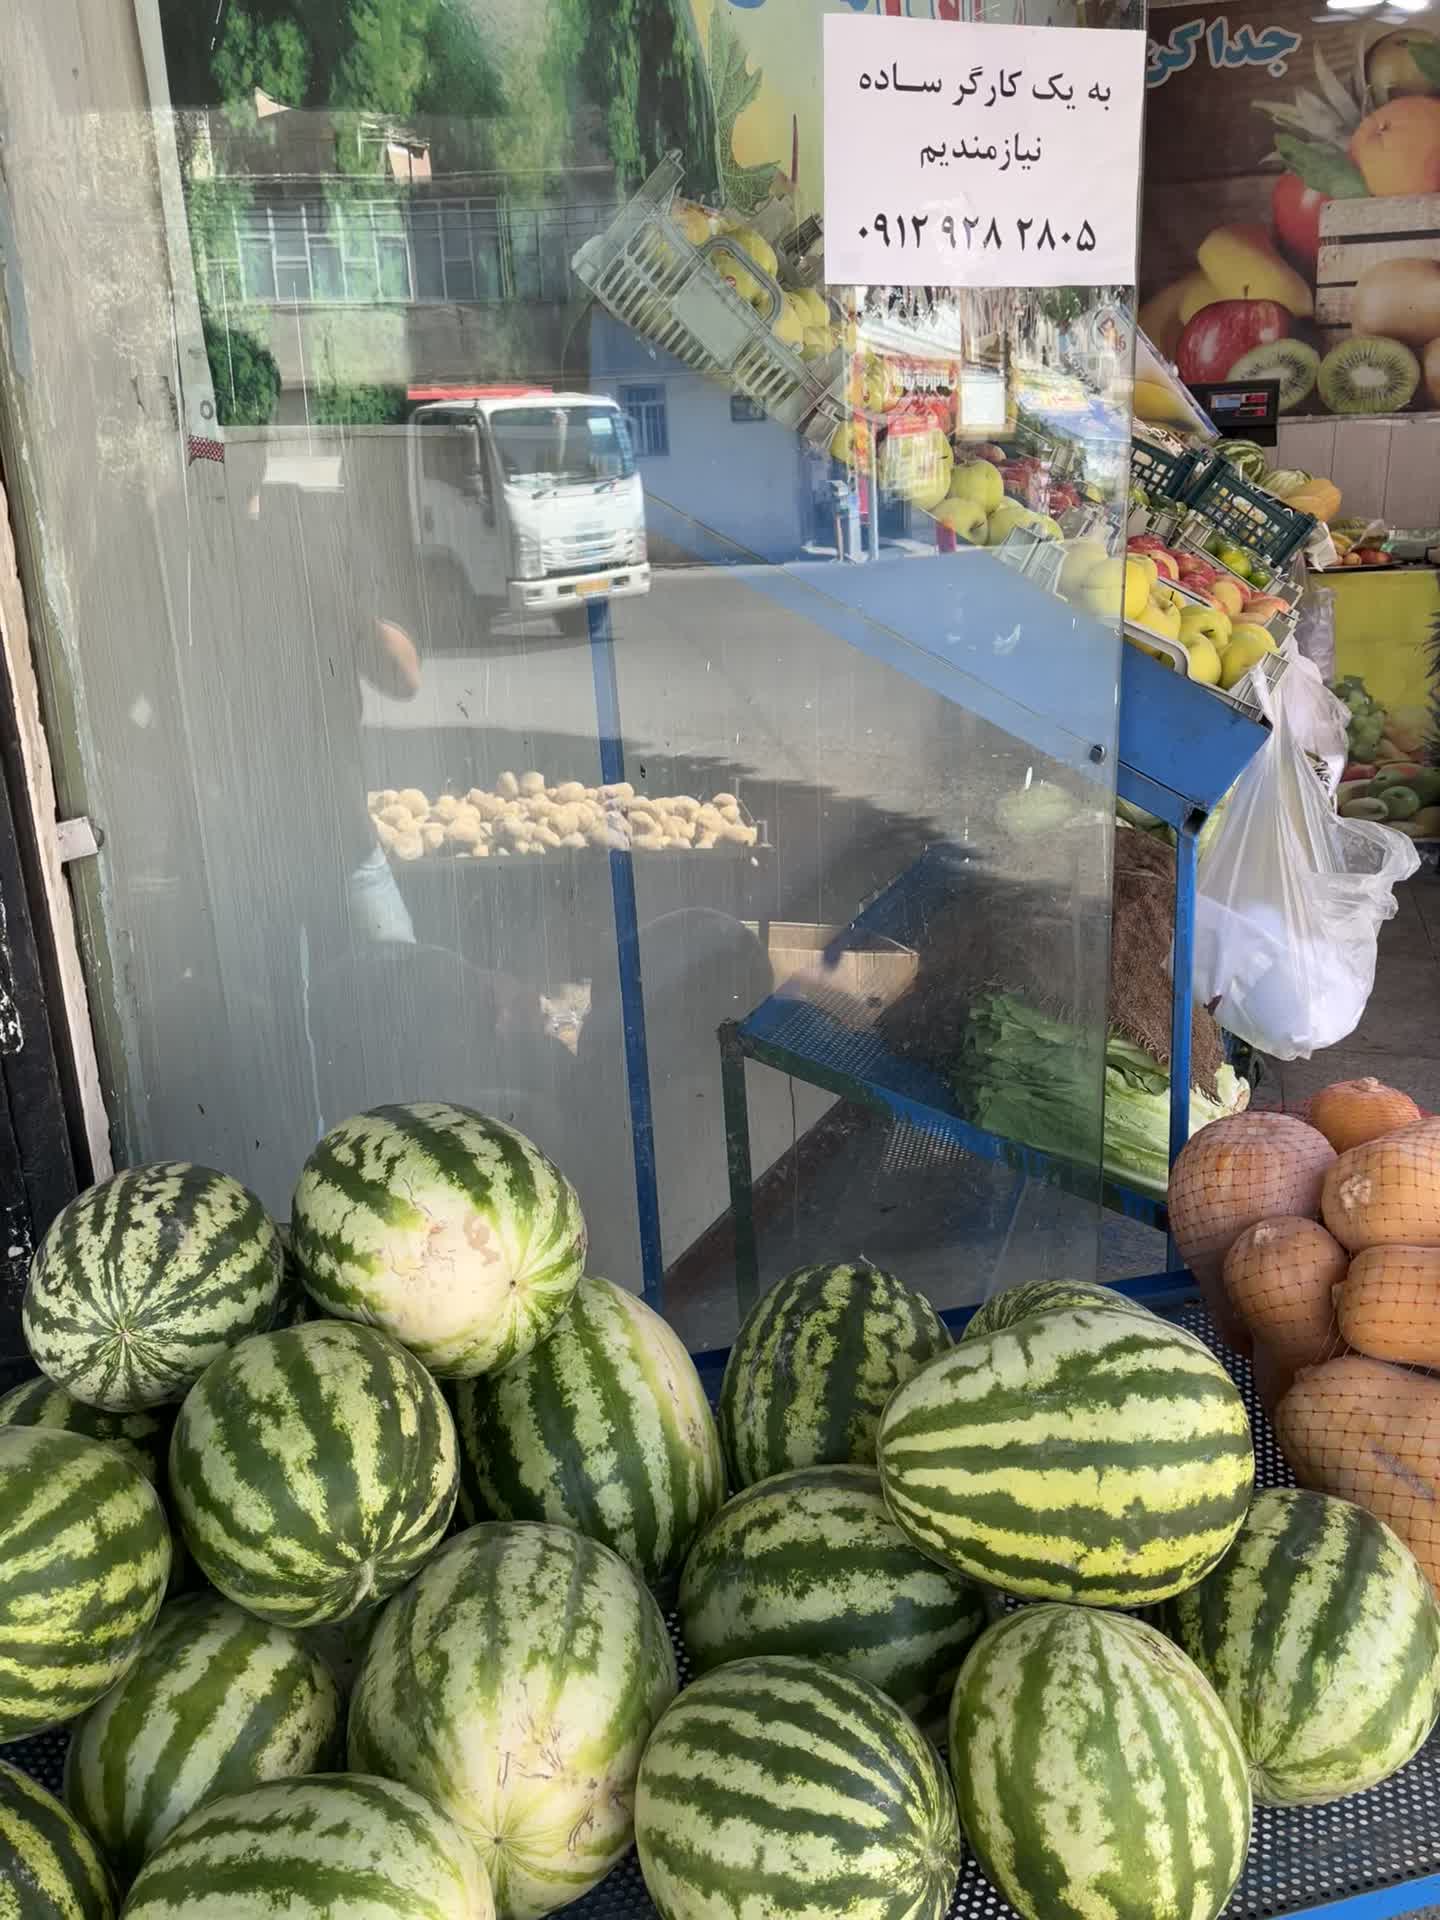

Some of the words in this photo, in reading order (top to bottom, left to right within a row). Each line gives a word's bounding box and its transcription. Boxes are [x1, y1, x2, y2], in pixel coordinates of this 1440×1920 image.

[1206, 16, 1303, 78] جدا
[859, 62, 942, 93] ساده
[952, 66, 1023, 107] کارگر
[1031, 72, 1075, 110] یک
[1087, 82, 1111, 111] به
[920, 132, 1041, 171] نیازمندیم
[858, 213, 929, 249] ۰۹۱۲
[941, 215, 1002, 250] ۹۲۸
[1016, 217, 1097, 252] ۲۸۰۵
